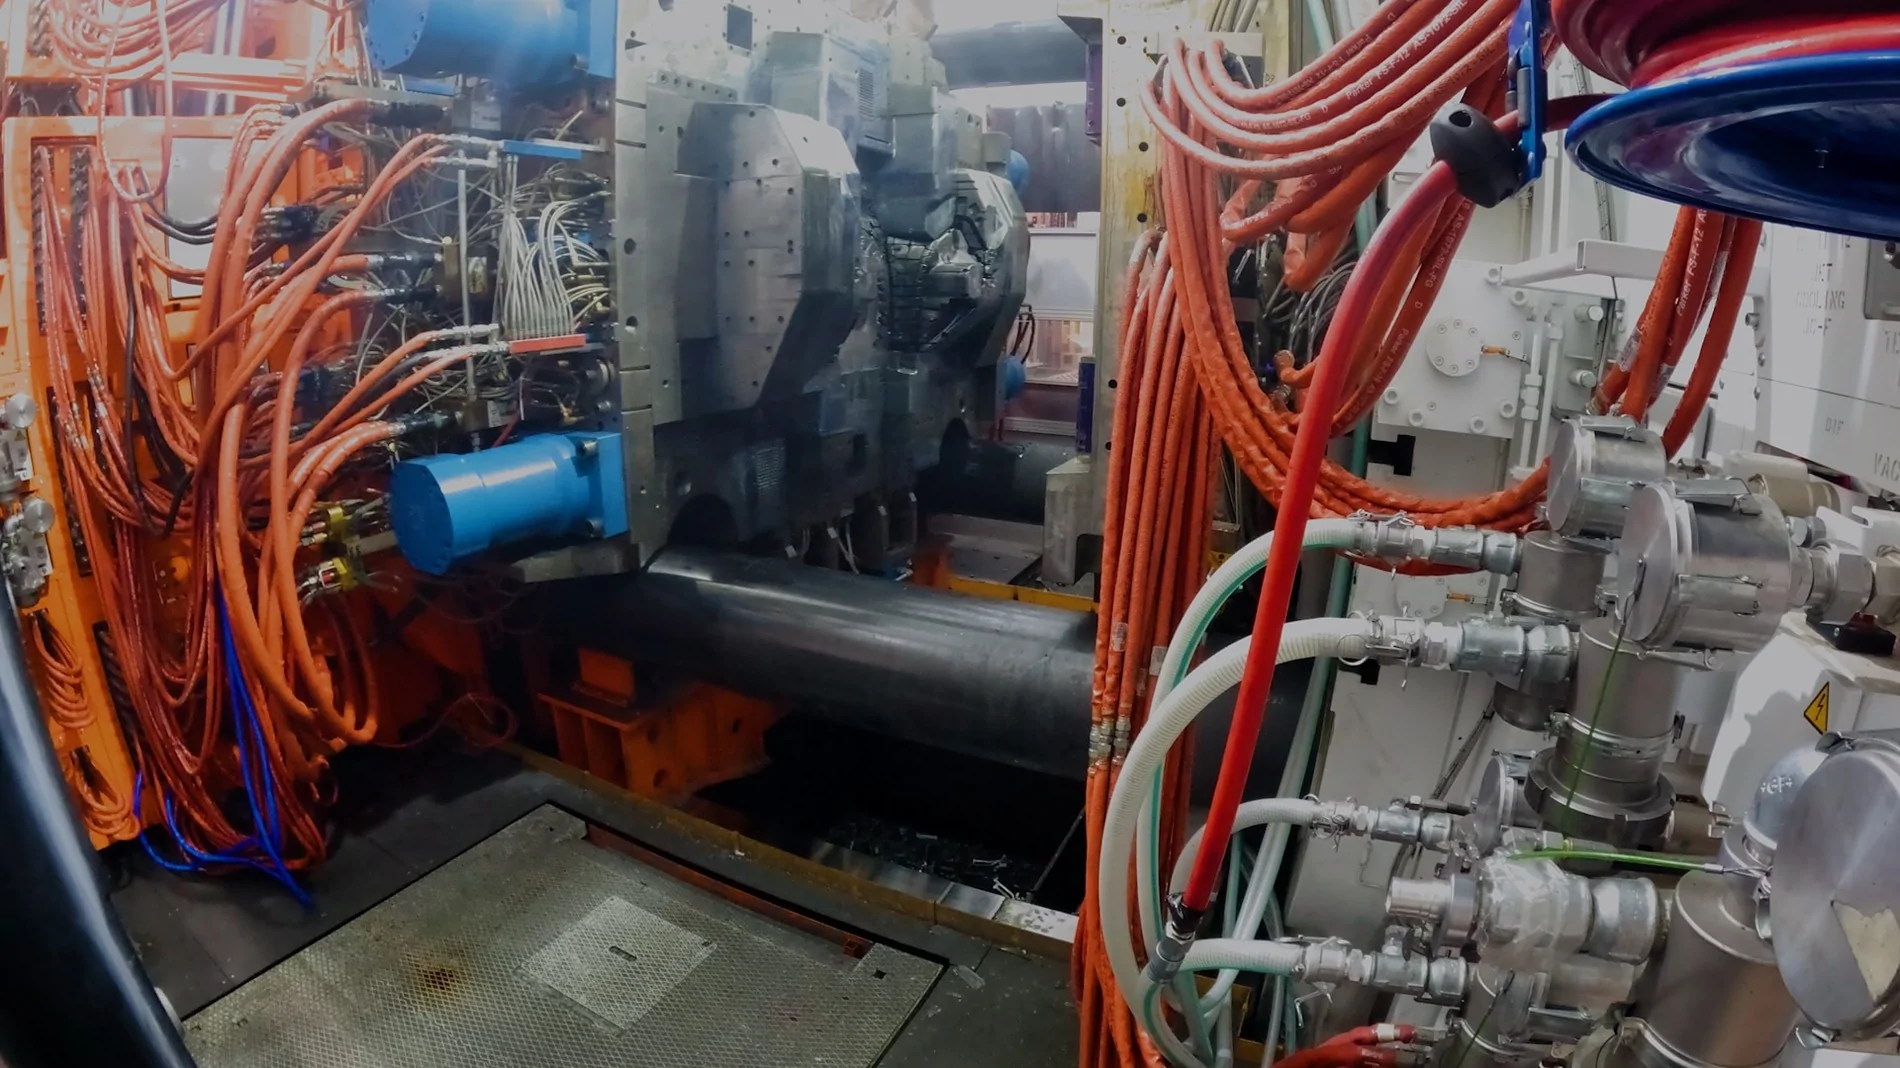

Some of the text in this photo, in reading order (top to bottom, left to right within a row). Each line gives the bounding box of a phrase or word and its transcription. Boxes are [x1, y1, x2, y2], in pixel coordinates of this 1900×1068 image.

[1345, 77, 1374, 101] Parker
[1675, 279, 1693, 317] Parker
[1686, 226, 1706, 277] FS-F-12
[1795, 288, 1846, 310] COOLING
